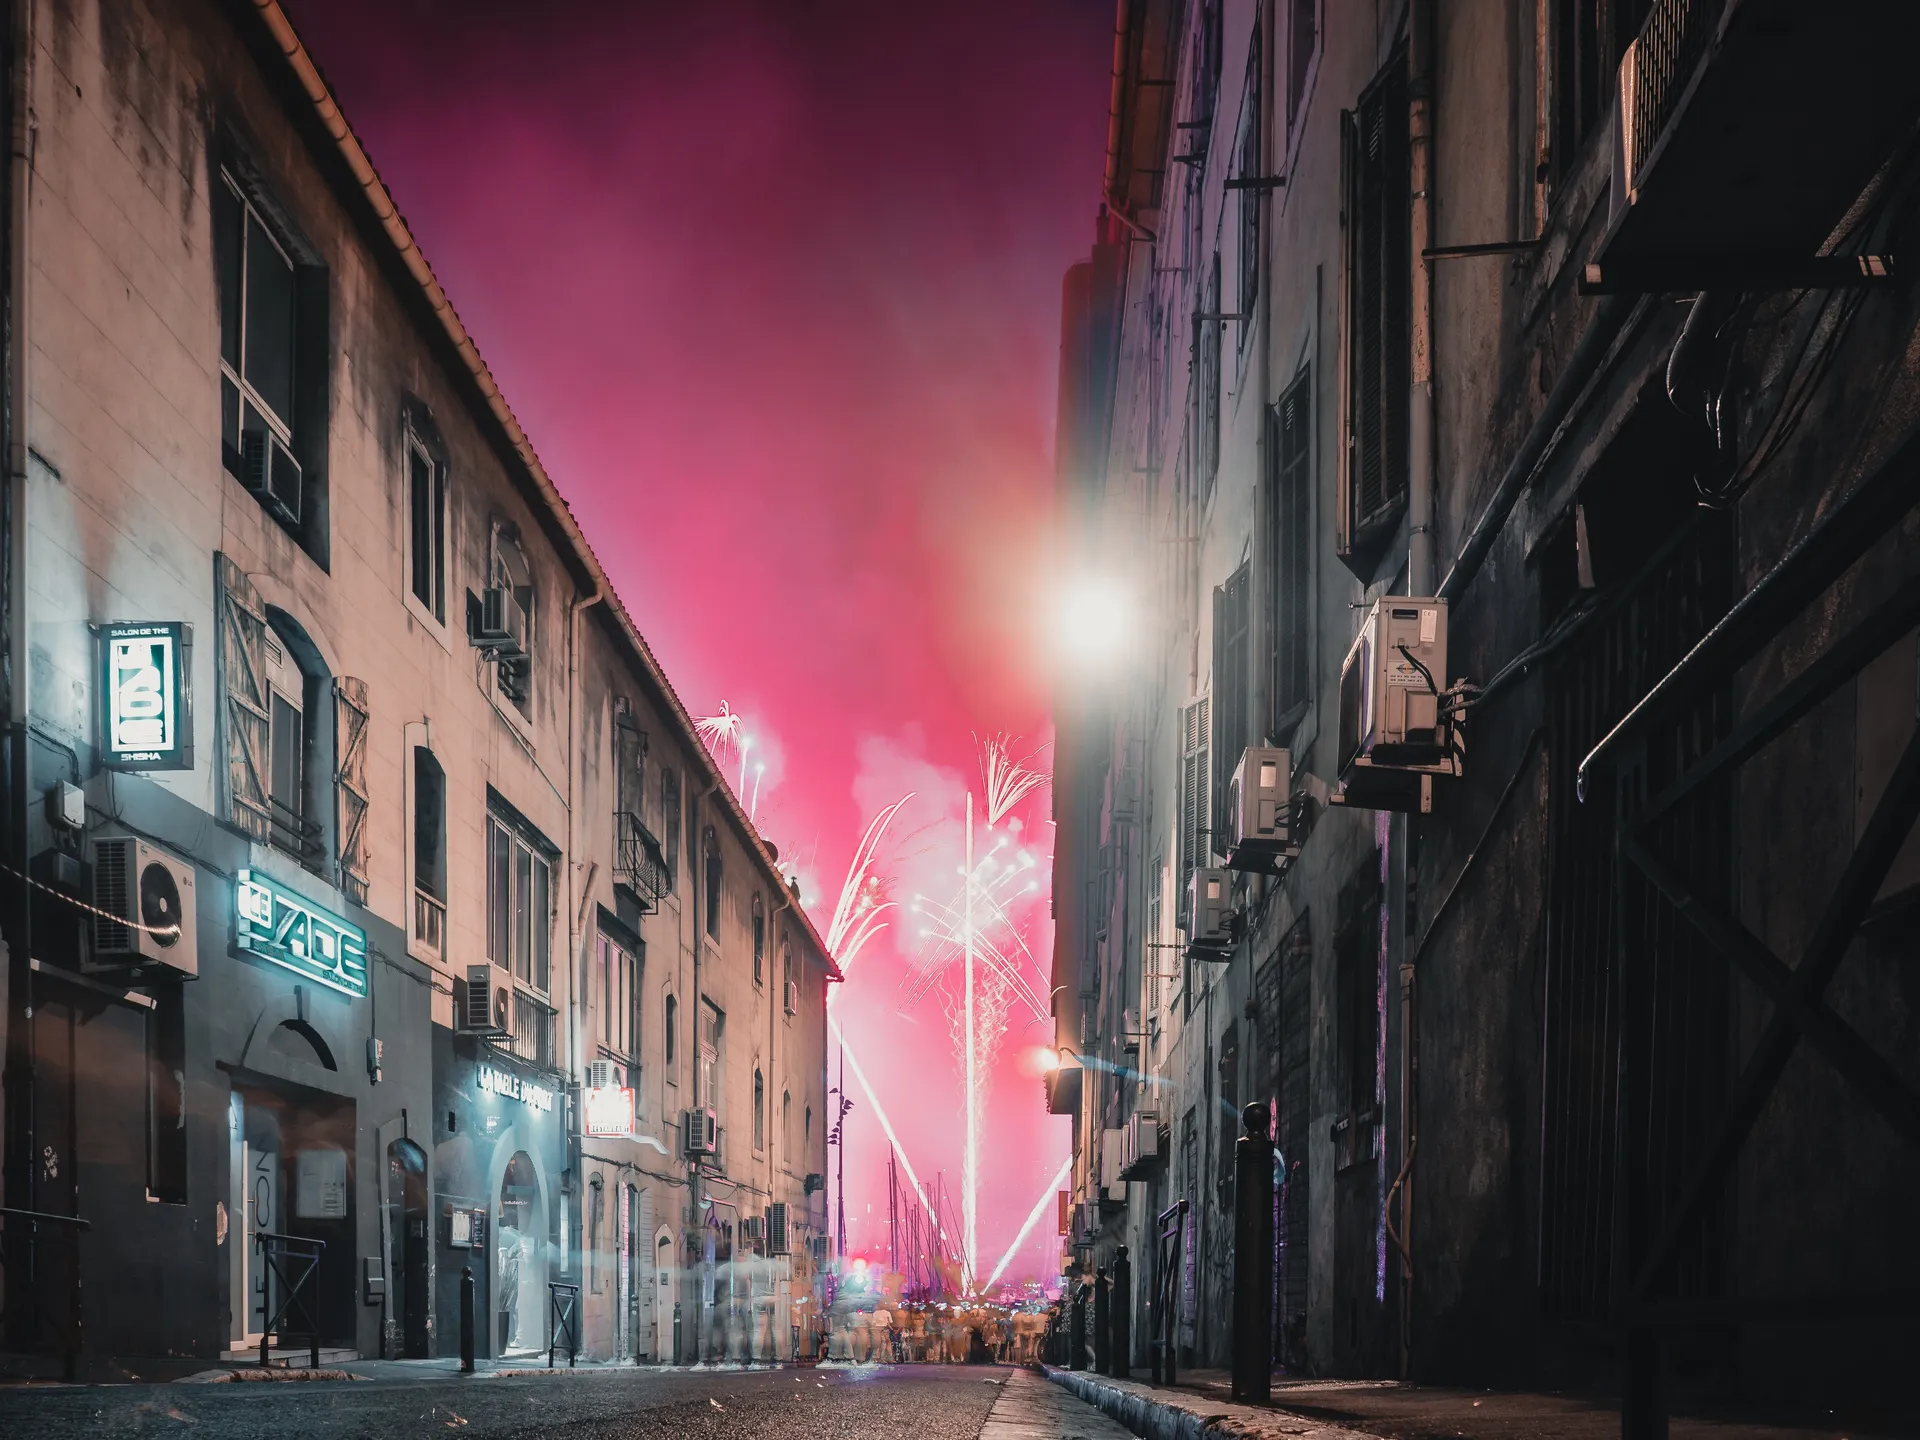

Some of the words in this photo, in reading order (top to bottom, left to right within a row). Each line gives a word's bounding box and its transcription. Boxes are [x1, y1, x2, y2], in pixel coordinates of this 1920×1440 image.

[121, 752, 161, 761] SHISHA
[249, 886, 367, 990] JADE
[480, 1064, 494, 1094] LA
[494, 1069, 520, 1100] TABLE
